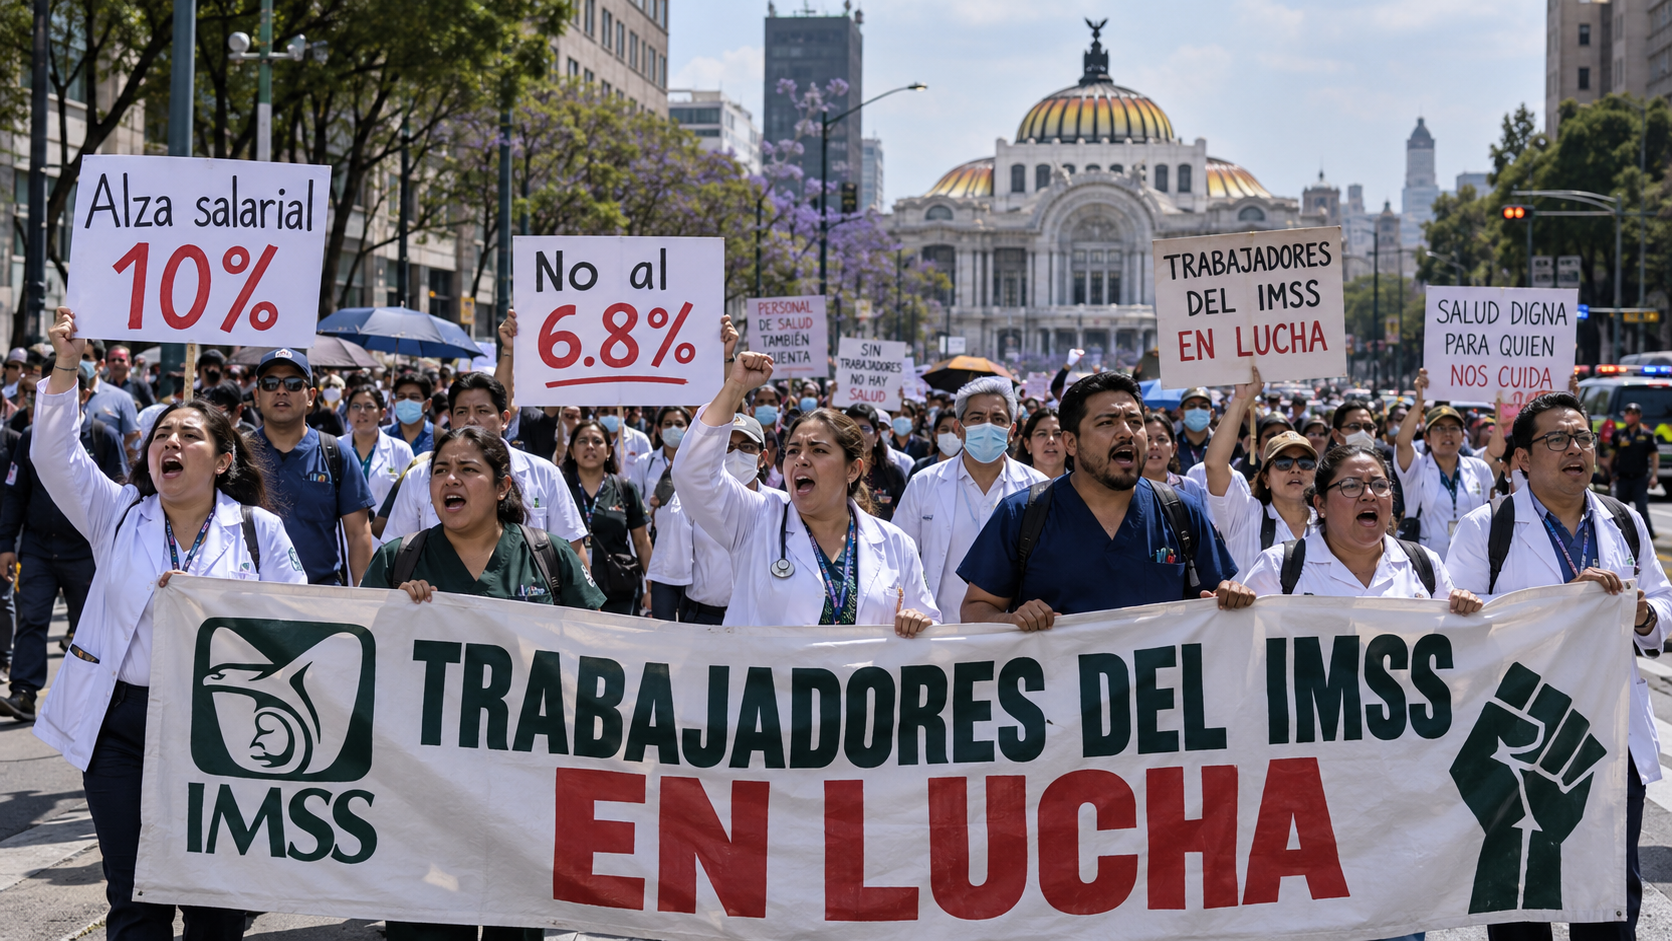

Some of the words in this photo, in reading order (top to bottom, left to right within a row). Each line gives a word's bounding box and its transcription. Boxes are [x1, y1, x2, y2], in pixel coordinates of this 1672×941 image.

[84, 172, 174, 229] Alza
[194, 174, 314, 232] salarial
[535, 250, 599, 293] No
[629, 247, 667, 291] al
[1163, 241, 1332, 280] TRABAJADORES
[112, 242, 279, 334] 10%
[1186, 287, 1237, 317] DEL
[1257, 279, 1321, 311] IMSS
[758, 301, 813, 316] PERSONAL
[758, 318, 773, 331] DE
[777, 317, 813, 331] SALUD
[1436, 299, 1500, 325] SALUD
[1510, 300, 1568, 326] DIGNA
[537, 301, 696, 370] 6.8%
[761, 332, 810, 347] TAMBIÉN
[860, 343, 882, 357] SIN
[1177, 328, 1215, 362] EN
[1235, 320, 1329, 358] LUCHA
[1445, 332, 1490, 356] PARA
[1499, 334, 1555, 358] QUIEN
[840, 358, 902, 373] TRABAJADORES
[850, 373, 865, 386] NO
[868, 375, 888, 387] HAY
[1450, 364, 1488, 388] NOS
[1497, 365, 1553, 390] CUIDA
[849, 388, 886, 403] SALUD
[413, 640, 1047, 768] TRABAJADORES
[1078, 643, 1228, 758] DEL
[1266, 633, 1454, 744] IMSS
[187, 783, 378, 864] IMSS
[553, 767, 770, 918] EN
[824, 757, 1351, 921] LUCHA
